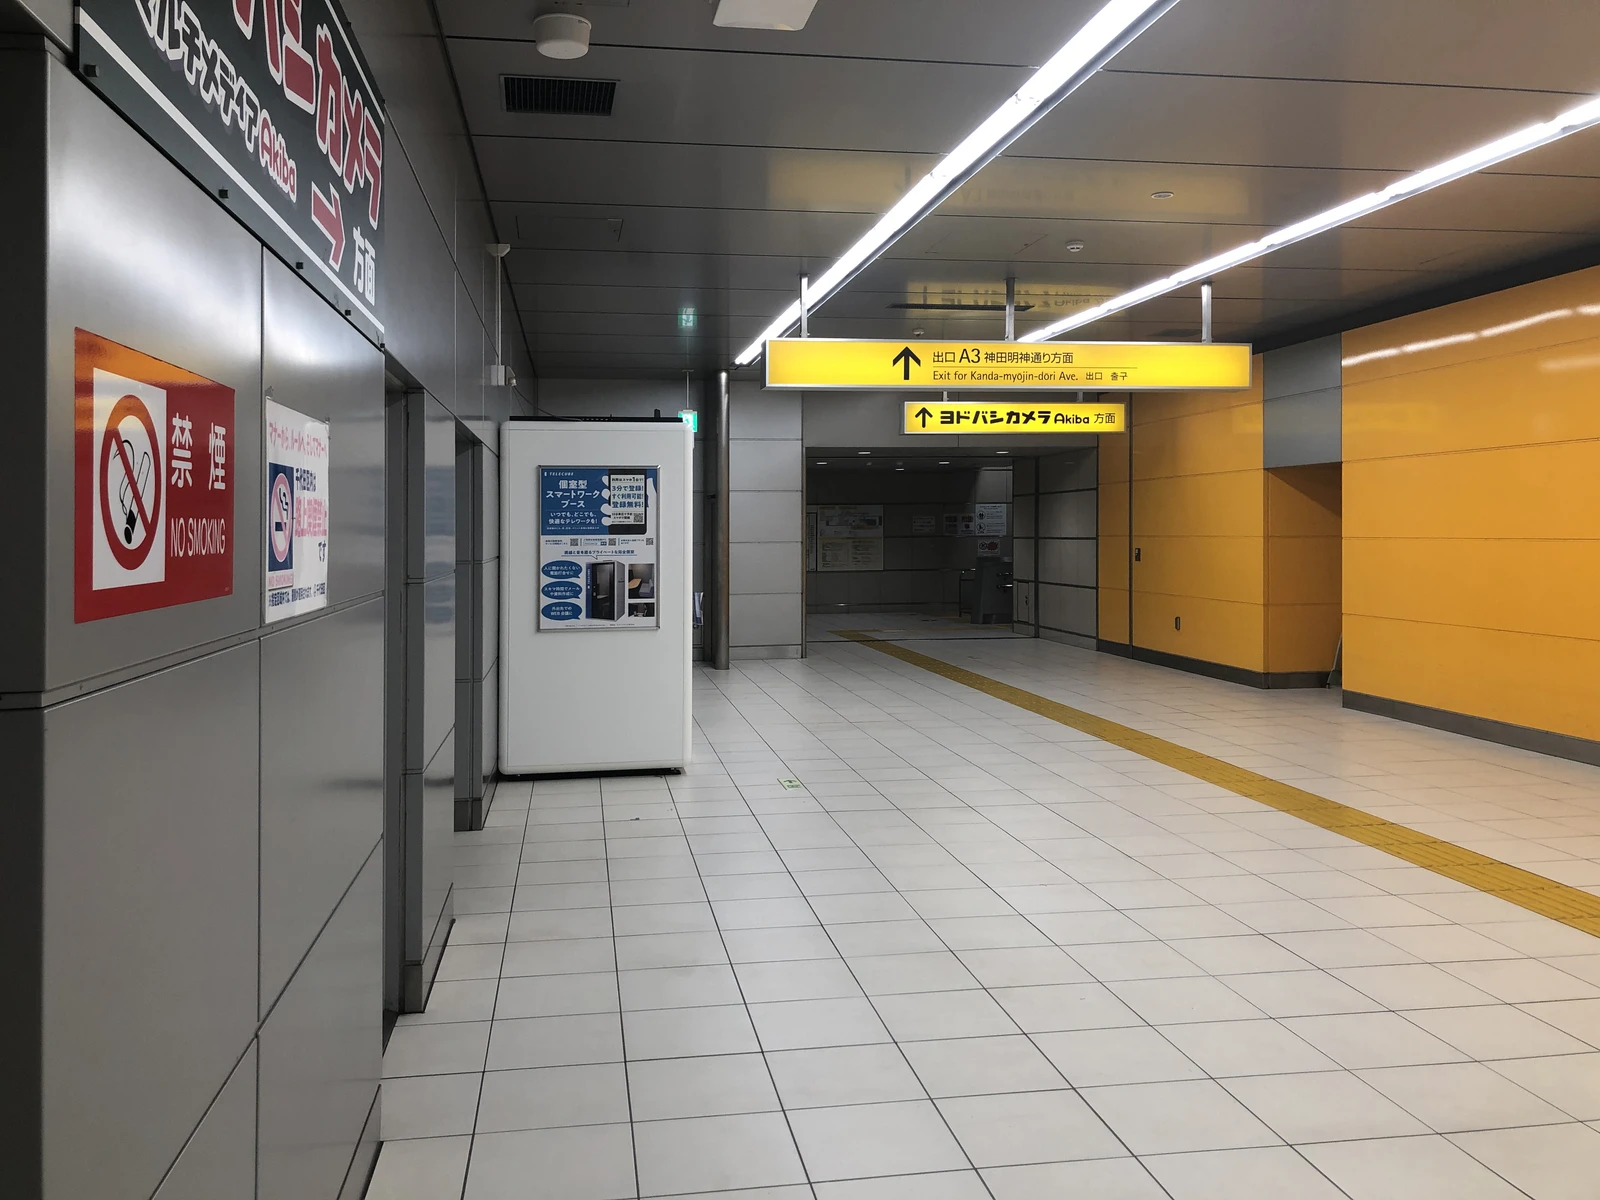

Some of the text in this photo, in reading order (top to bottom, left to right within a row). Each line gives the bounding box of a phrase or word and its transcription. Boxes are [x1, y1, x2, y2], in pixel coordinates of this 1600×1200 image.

[353, 226, 376, 307] 方面
[932, 348, 1074, 364] 出口 A3 神田明神通り方面
[933, 371, 950, 381] Exit
[954, 371, 967, 381] for
[970, 370, 1056, 383] Kanda-myōjin-dōri
[1059, 371, 1078, 381] Ave.
[1085, 371, 1103, 381] 出口
[940, 410, 1116, 425] ヨドバシカメラ Akiba 方面
[171, 412, 227, 491] 禁煙
[558, 479, 588, 489] 個室型
[546, 489, 600, 499] スマートワーク
[561, 499, 585, 508] ブース
[170, 516, 226, 558] NO SMOKING
